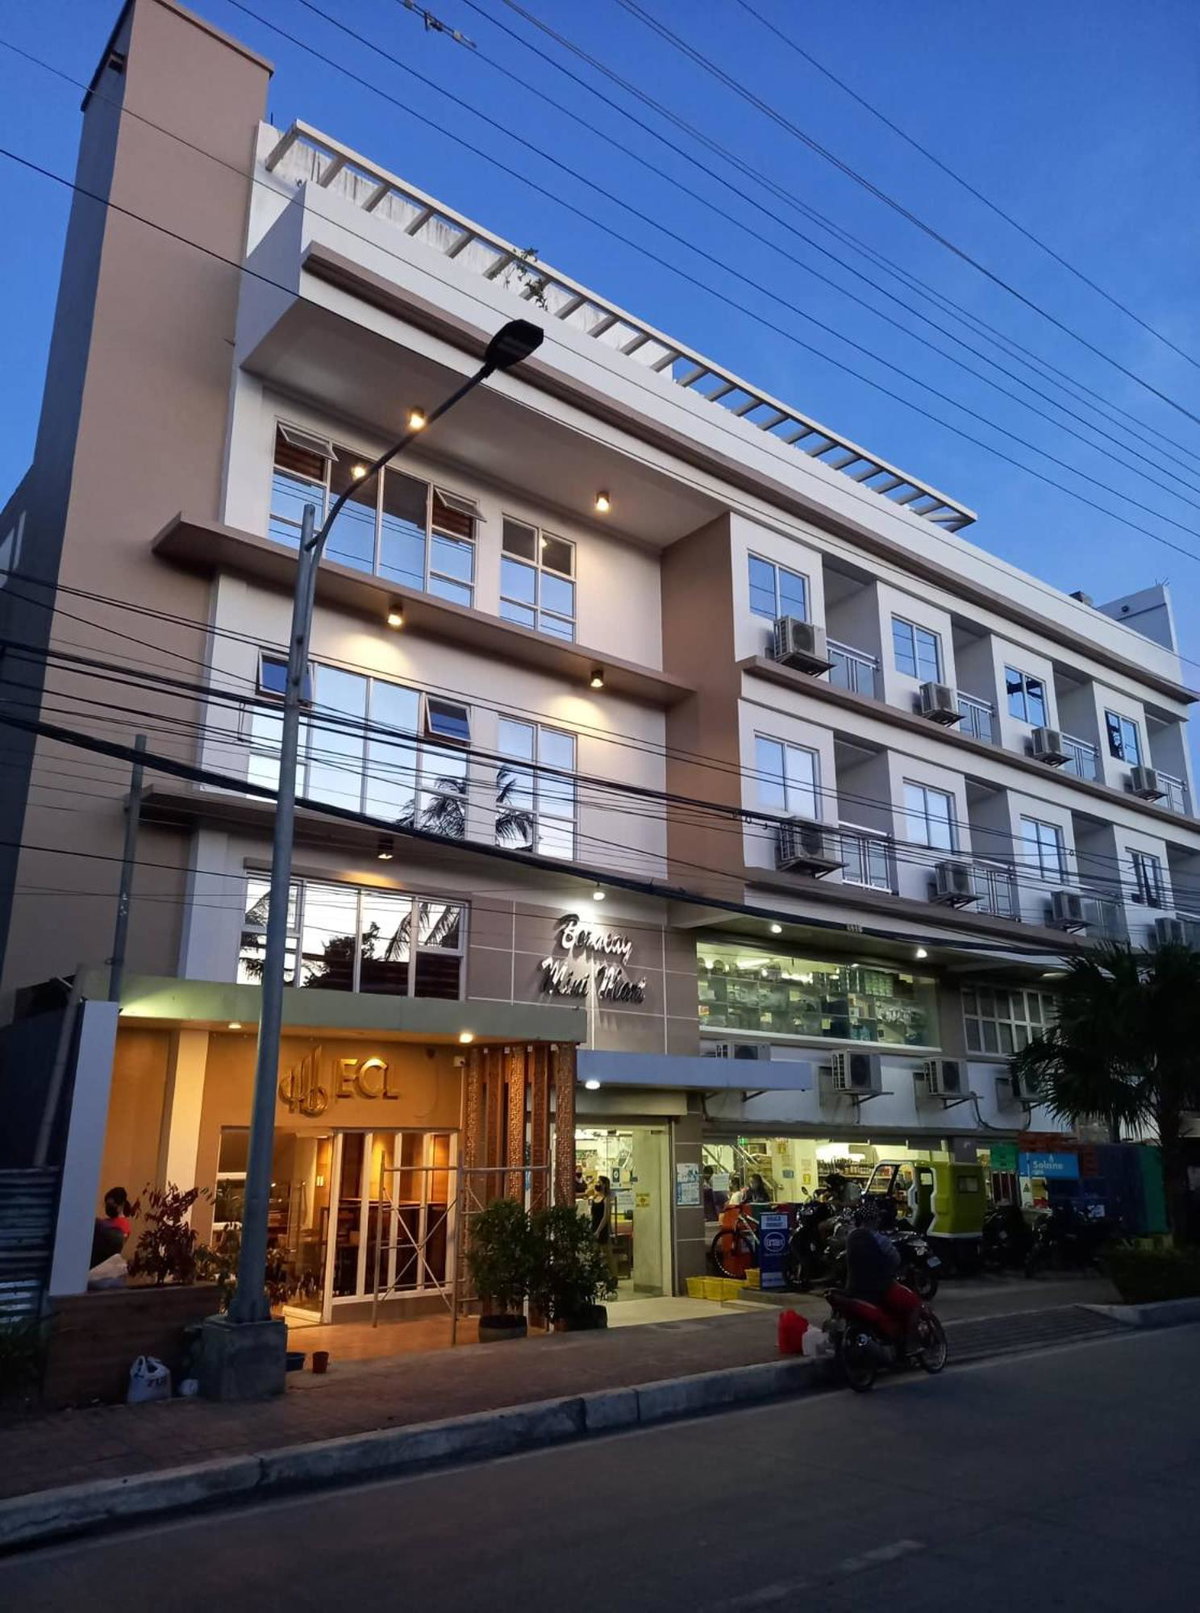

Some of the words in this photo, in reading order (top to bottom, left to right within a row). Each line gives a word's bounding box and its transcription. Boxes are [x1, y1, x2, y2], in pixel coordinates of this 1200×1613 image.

[540, 956, 591, 997] Mini
[335, 1057, 400, 1099] ECL
[1033, 1160, 1064, 1170] Solane
